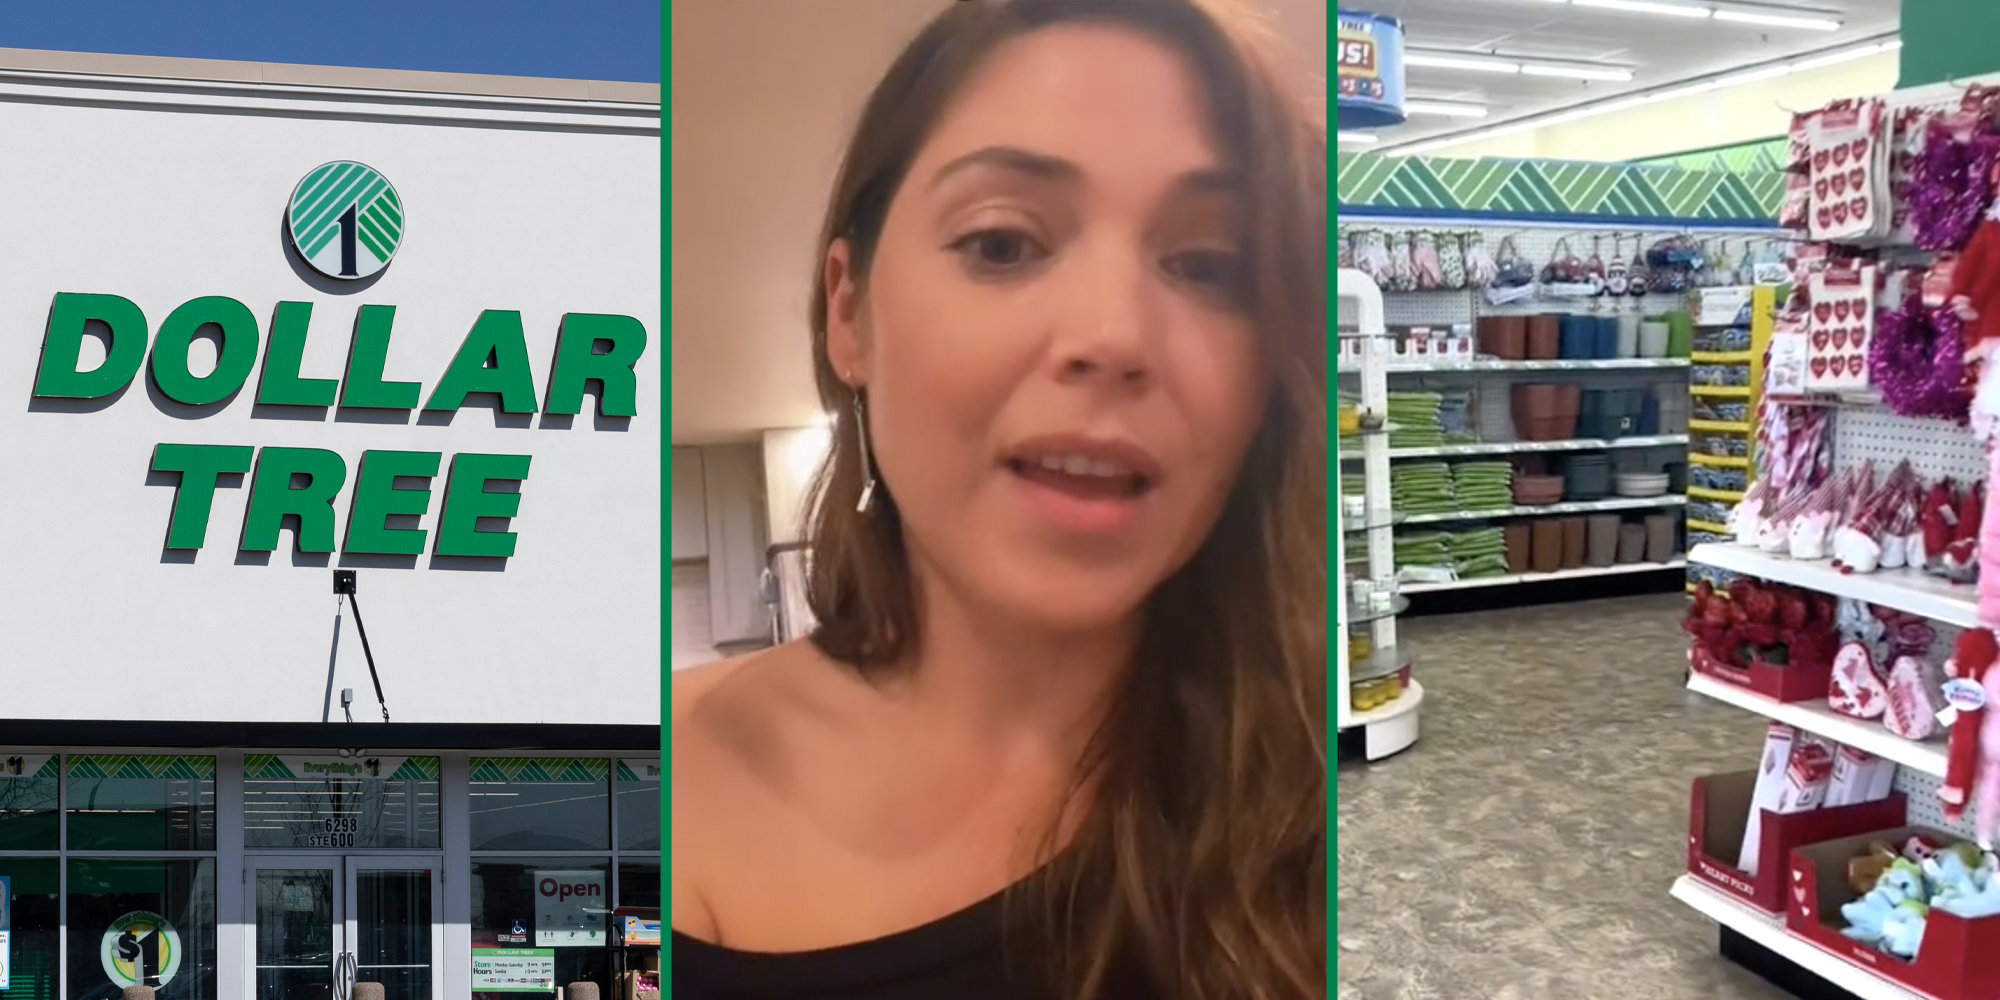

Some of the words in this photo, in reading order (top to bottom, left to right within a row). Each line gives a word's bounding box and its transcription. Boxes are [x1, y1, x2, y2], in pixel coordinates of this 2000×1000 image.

[34, 291, 647, 416] DOLLAR
[150, 443, 532, 557] TREE
[303, 762, 362, 776] Everything's
[325, 818, 357, 832] 6298
[309, 836, 330, 846] STE
[330, 833, 354, 847] 600
[539, 878, 601, 902] Open
[474, 960, 491, 968] Store
